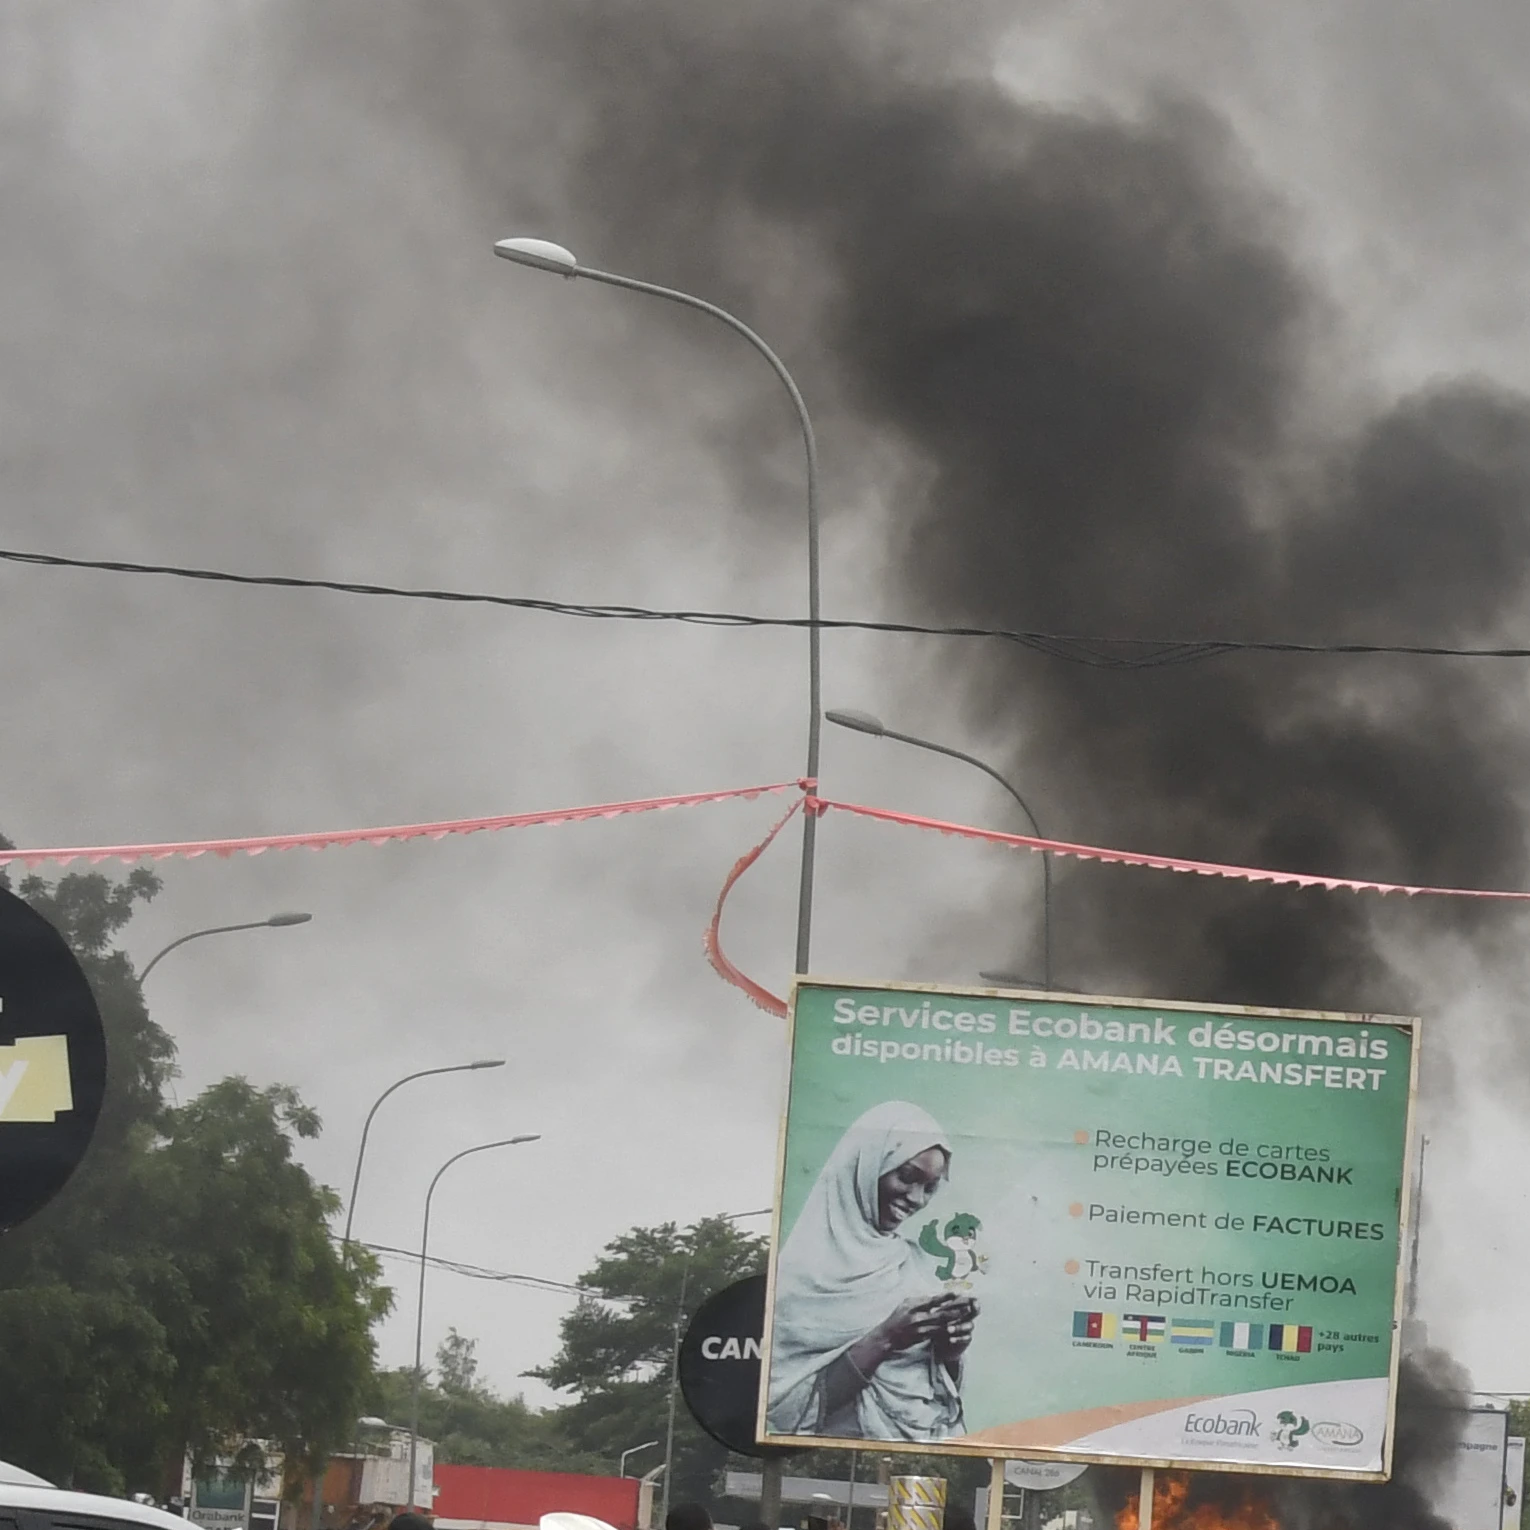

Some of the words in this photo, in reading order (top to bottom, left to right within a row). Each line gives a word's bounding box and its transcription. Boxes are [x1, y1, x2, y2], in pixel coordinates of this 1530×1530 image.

[833, 998, 996, 1033] Services
[1008, 1009, 1176, 1047] Ecobank
[1188, 1021, 1389, 1060] désormais
[831, 1033, 1019, 1067] disponibles
[1029, 1045, 1046, 1068] à
[1057, 1048, 1183, 1077] AMANA
[1193, 1056, 1388, 1091] TRANSFERT
[1095, 1129, 1212, 1157] Recharge
[1219, 1138, 1249, 1156] de
[1256, 1144, 1330, 1162] cartes
[1093, 1152, 1218, 1177] prépayées
[1226, 1160, 1354, 1185] ECOBANK
[1089, 1204, 1208, 1229] Paiement
[1214, 1213, 1245, 1231] de
[1253, 1215, 1384, 1241] FACTURES
[1086, 1260, 1194, 1284] Transfert
[1201, 1267, 1254, 1287] hors
[1261, 1272, 1357, 1295] UEMOA
[1084, 1281, 1117, 1300] via
[1125, 1283, 1294, 1311] RapidTransfer
[1317, 1342, 1345, 1353] pays
[1318, 1330, 1341, 1341] +28
[1343, 1332, 1380, 1344] autres
[1184, 1409, 1263, 1437] Ecobank
[192, 1510, 245, 1522] Orabank
